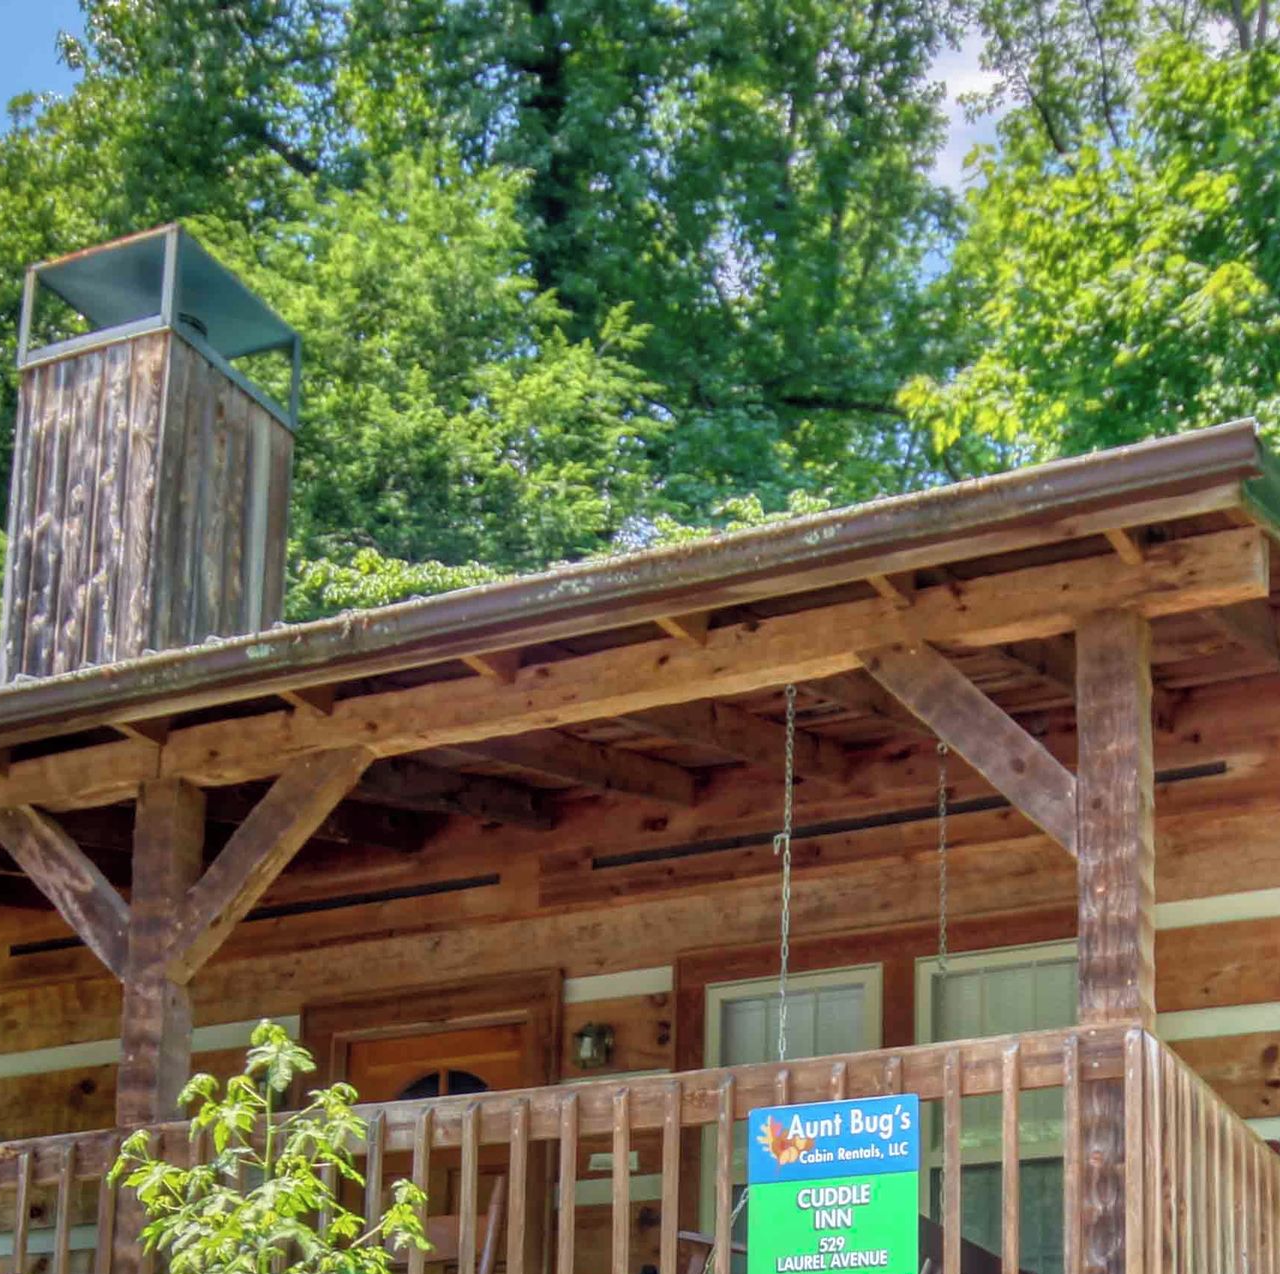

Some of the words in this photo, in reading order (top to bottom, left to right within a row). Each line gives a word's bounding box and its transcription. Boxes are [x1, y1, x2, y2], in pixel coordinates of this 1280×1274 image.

[787, 1113, 841, 1140] Aunt
[850, 1104, 911, 1139] Bug's
[799, 1150, 834, 1165] Cabin
[838, 1145, 884, 1161] Rentals,
[889, 1141, 909, 1156] LLC
[797, 1184, 871, 1208] CUDDLE
[815, 1208, 852, 1230] INN
[819, 1236, 845, 1253] 529
[777, 1254, 826, 1272] LAUREL
[830, 1249, 888, 1268] AVENUE
